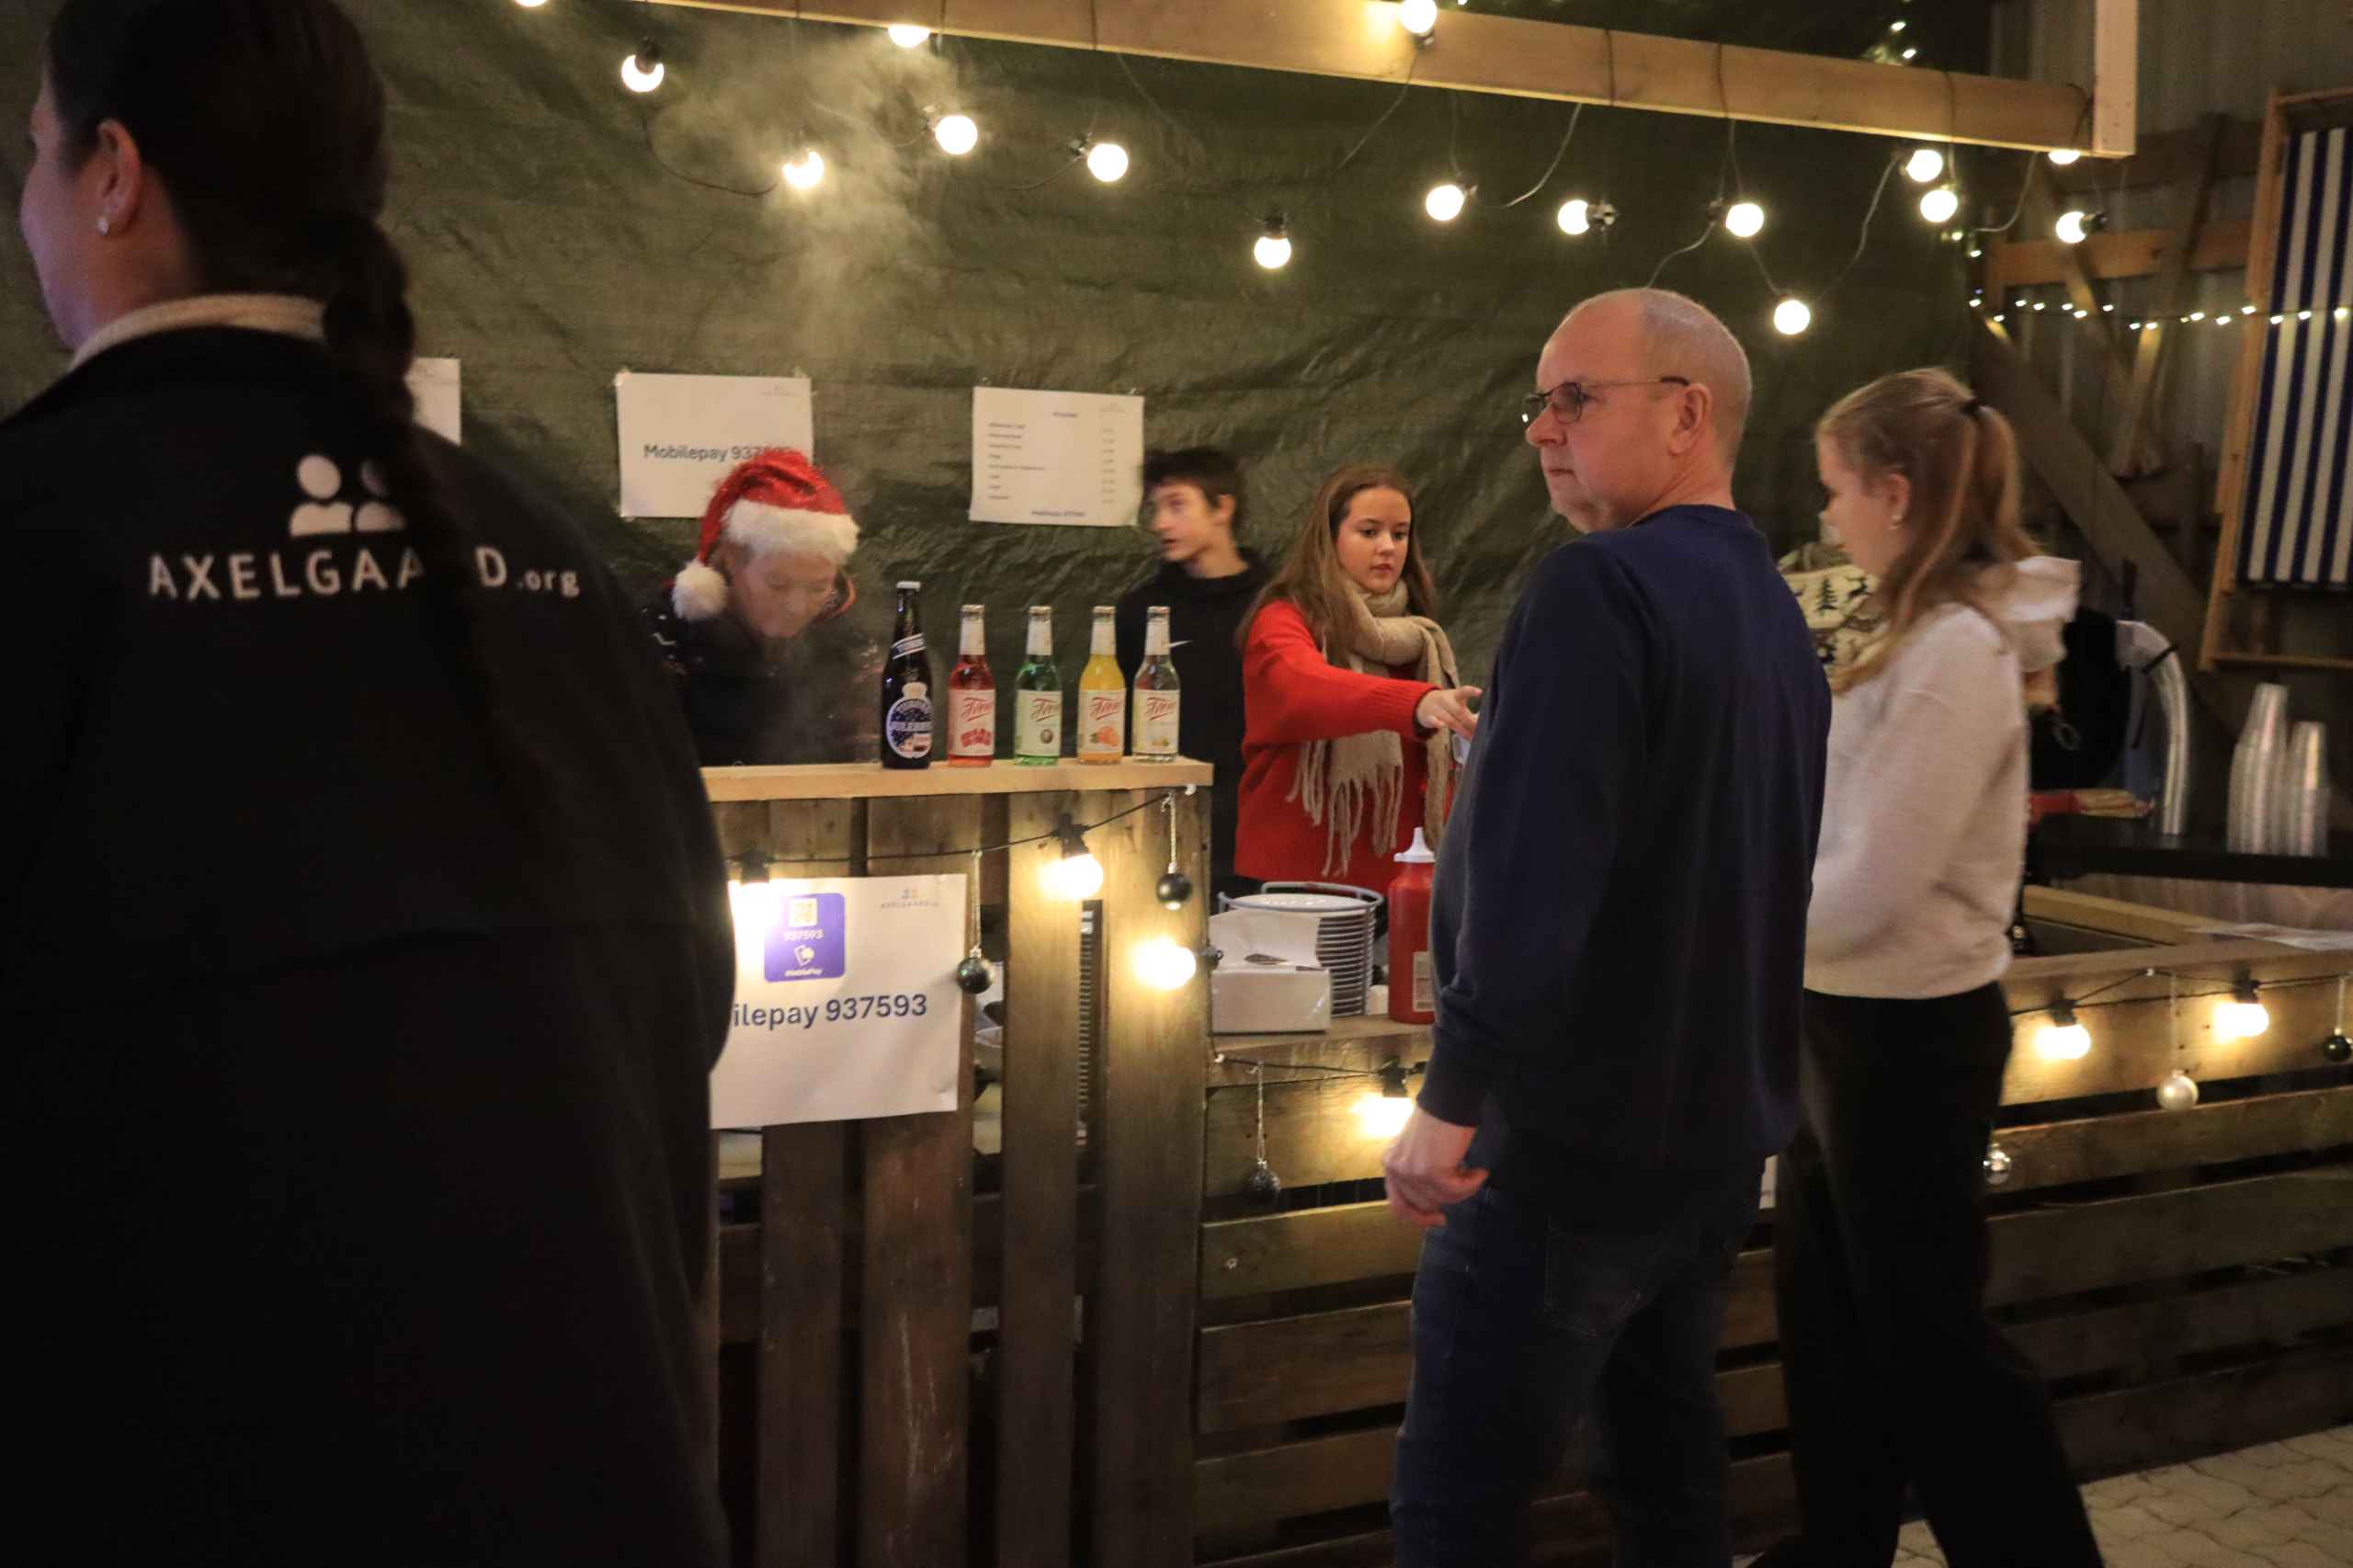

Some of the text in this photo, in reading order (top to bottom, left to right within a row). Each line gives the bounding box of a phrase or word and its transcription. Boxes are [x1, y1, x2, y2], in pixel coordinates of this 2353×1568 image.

[644, 444, 728, 462] Mobilepay
[149, 546, 580, 599] AXELGAAD.org
[733, 994, 927, 1030] ilepay 937593
